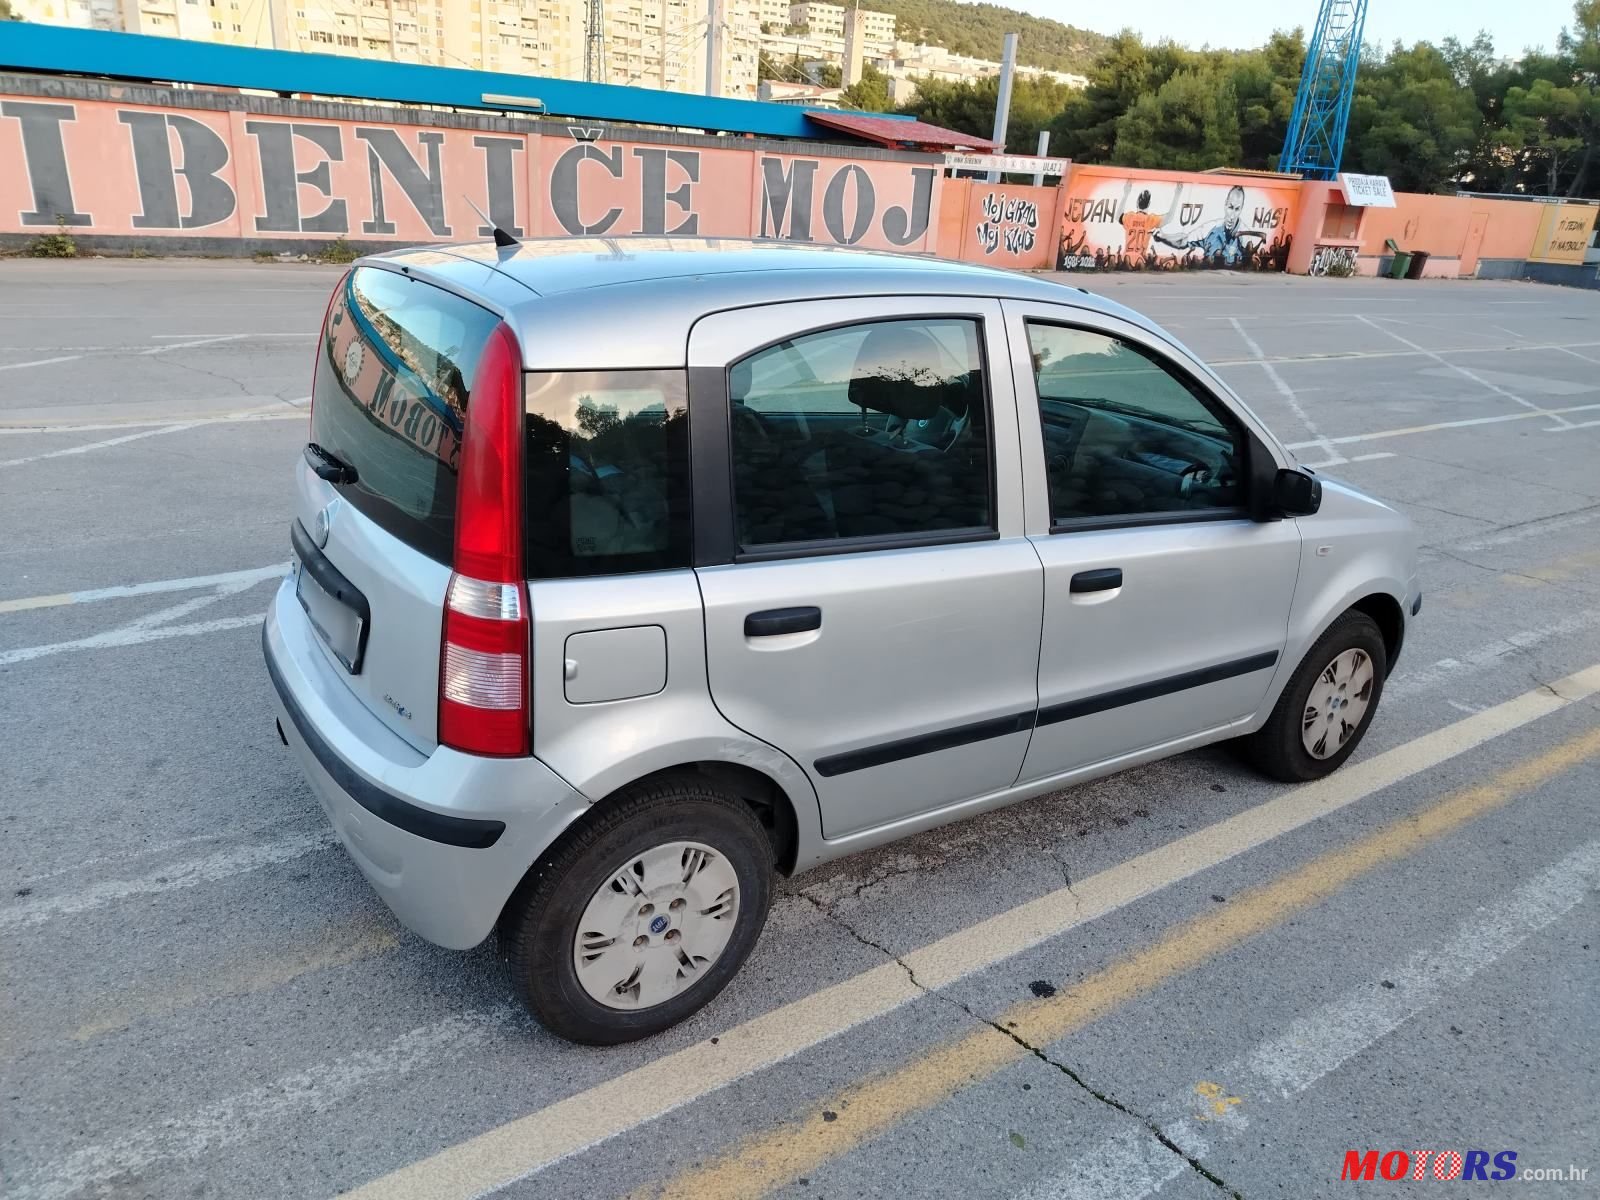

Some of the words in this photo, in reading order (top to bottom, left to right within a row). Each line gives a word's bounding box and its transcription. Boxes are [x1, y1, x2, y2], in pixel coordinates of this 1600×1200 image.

[1043, 162, 1057, 172] ULAZ
[759, 156, 938, 246] MOJ
[1352, 184, 1371, 196] TICKET
[1373, 187, 1387, 197] SALE
[1005, 199, 1038, 228] GRAD
[1064, 198, 1117, 223] JEDAN
[1180, 203, 1204, 227] OD
